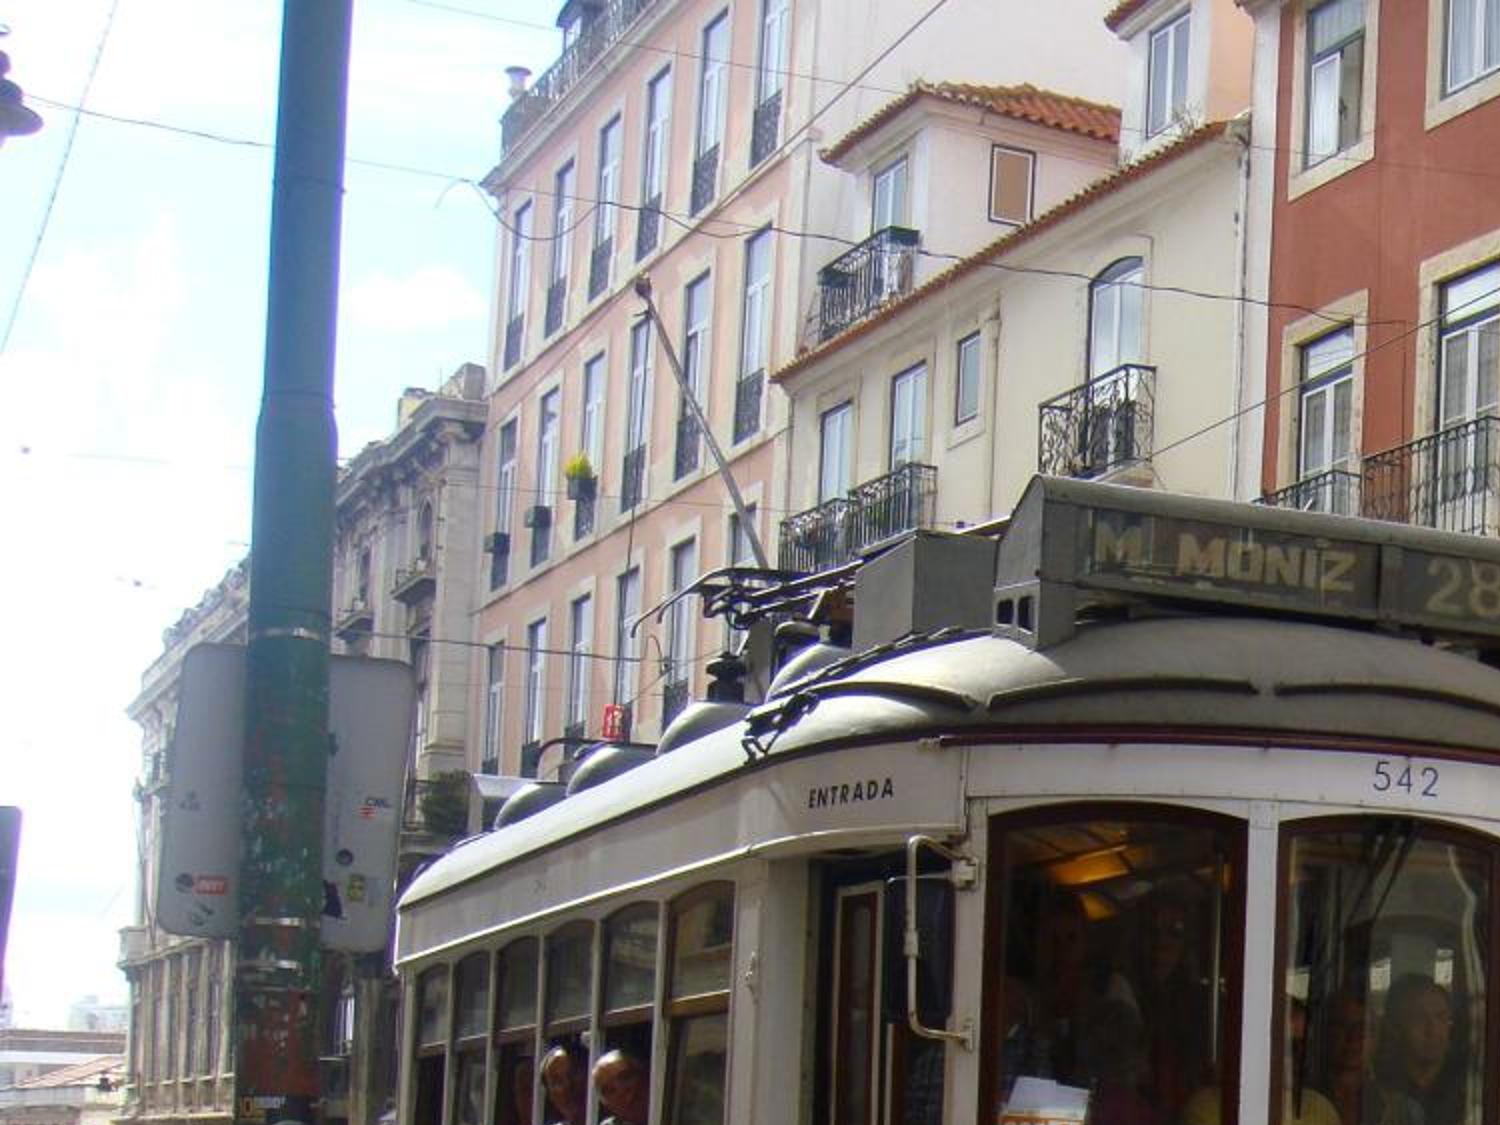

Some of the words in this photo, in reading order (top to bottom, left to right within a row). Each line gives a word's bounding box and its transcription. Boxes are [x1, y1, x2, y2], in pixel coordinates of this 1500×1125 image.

[1178, 532, 1357, 592] MONIZ
[809, 778, 893, 808] ENTRADA
[1373, 761, 1439, 797] 542
